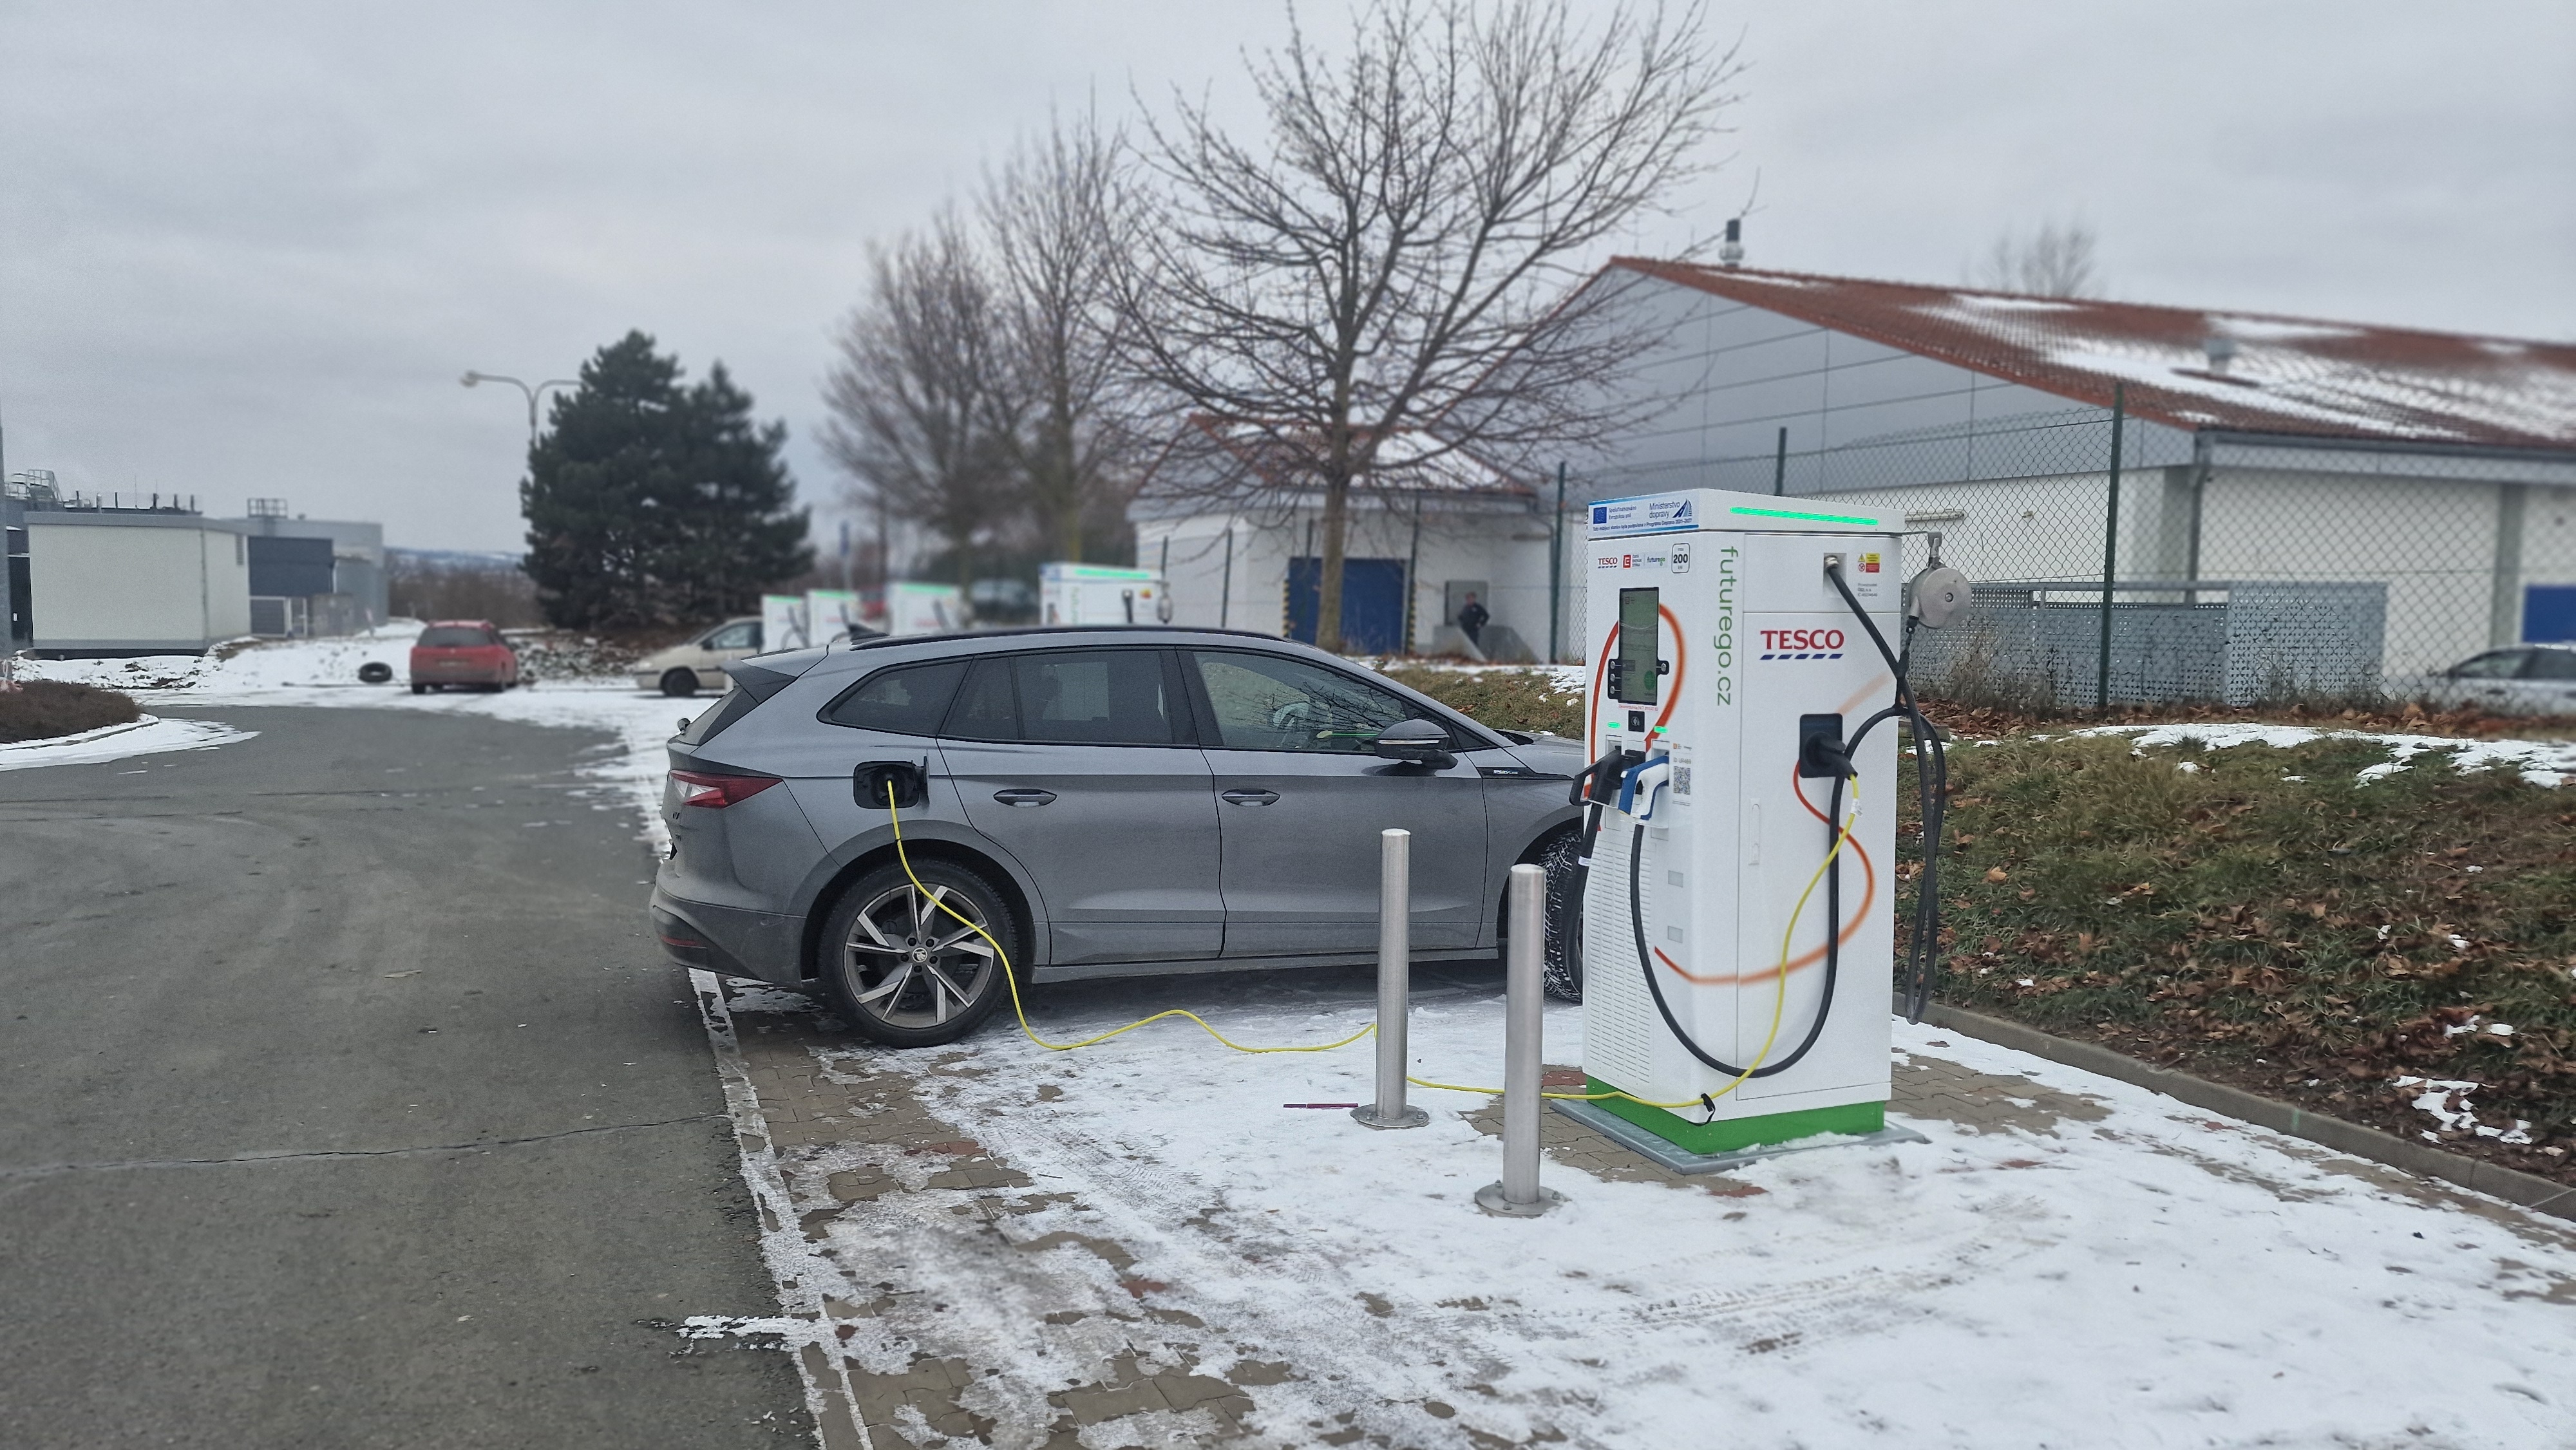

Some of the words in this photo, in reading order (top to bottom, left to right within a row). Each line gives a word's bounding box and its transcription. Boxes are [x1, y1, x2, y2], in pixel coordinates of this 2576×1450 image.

[1649, 502, 1681, 510] Ministerstvo
[1649, 511, 1670, 519] dopravy
[1598, 557, 1618, 565] TESCO
[1673, 554, 1689, 563] 200
[1714, 546, 1738, 706] futurego.cz
[1760, 629, 1844, 650] TESCO
